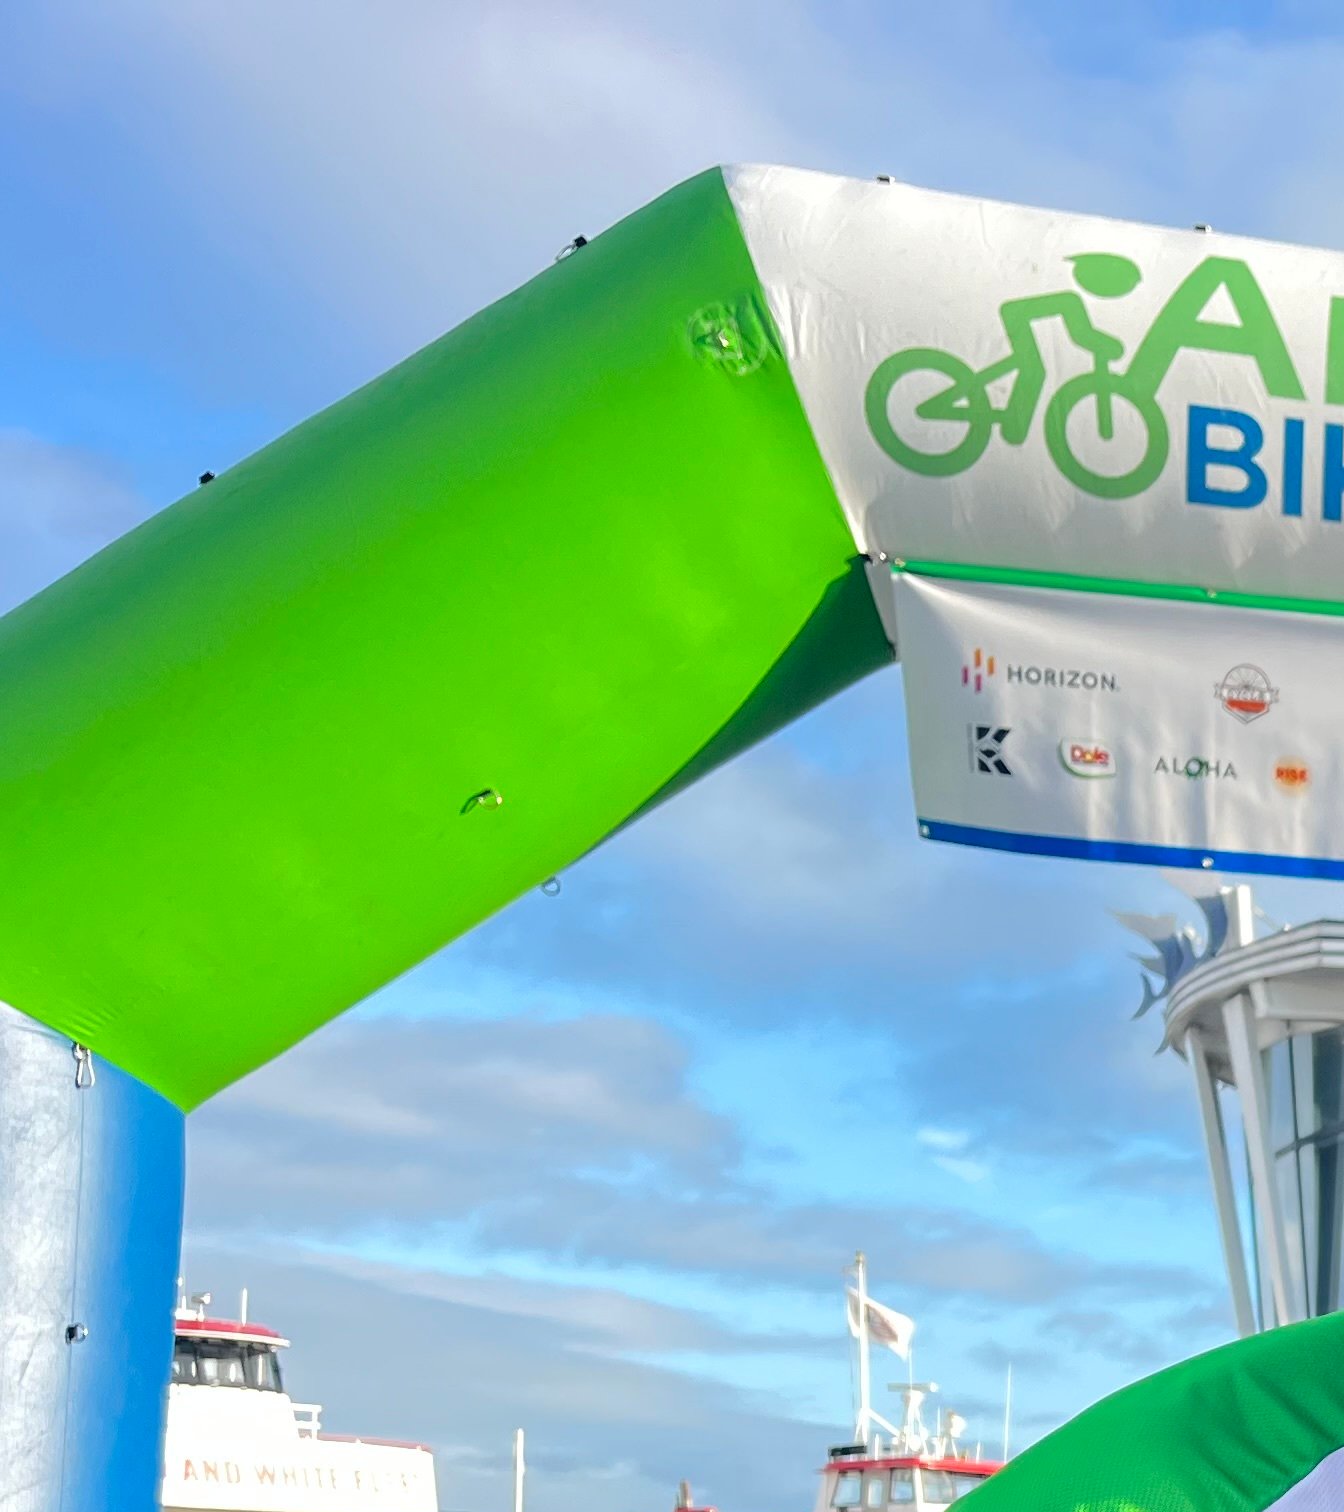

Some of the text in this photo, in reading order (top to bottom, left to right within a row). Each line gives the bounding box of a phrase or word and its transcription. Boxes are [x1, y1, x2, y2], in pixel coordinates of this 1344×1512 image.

[1007, 663, 1116, 692] HORIZON
[1153, 755, 1238, 781] ALOHA
[184, 1459, 241, 1484] AND
[254, 1464, 338, 1490] WHITE
